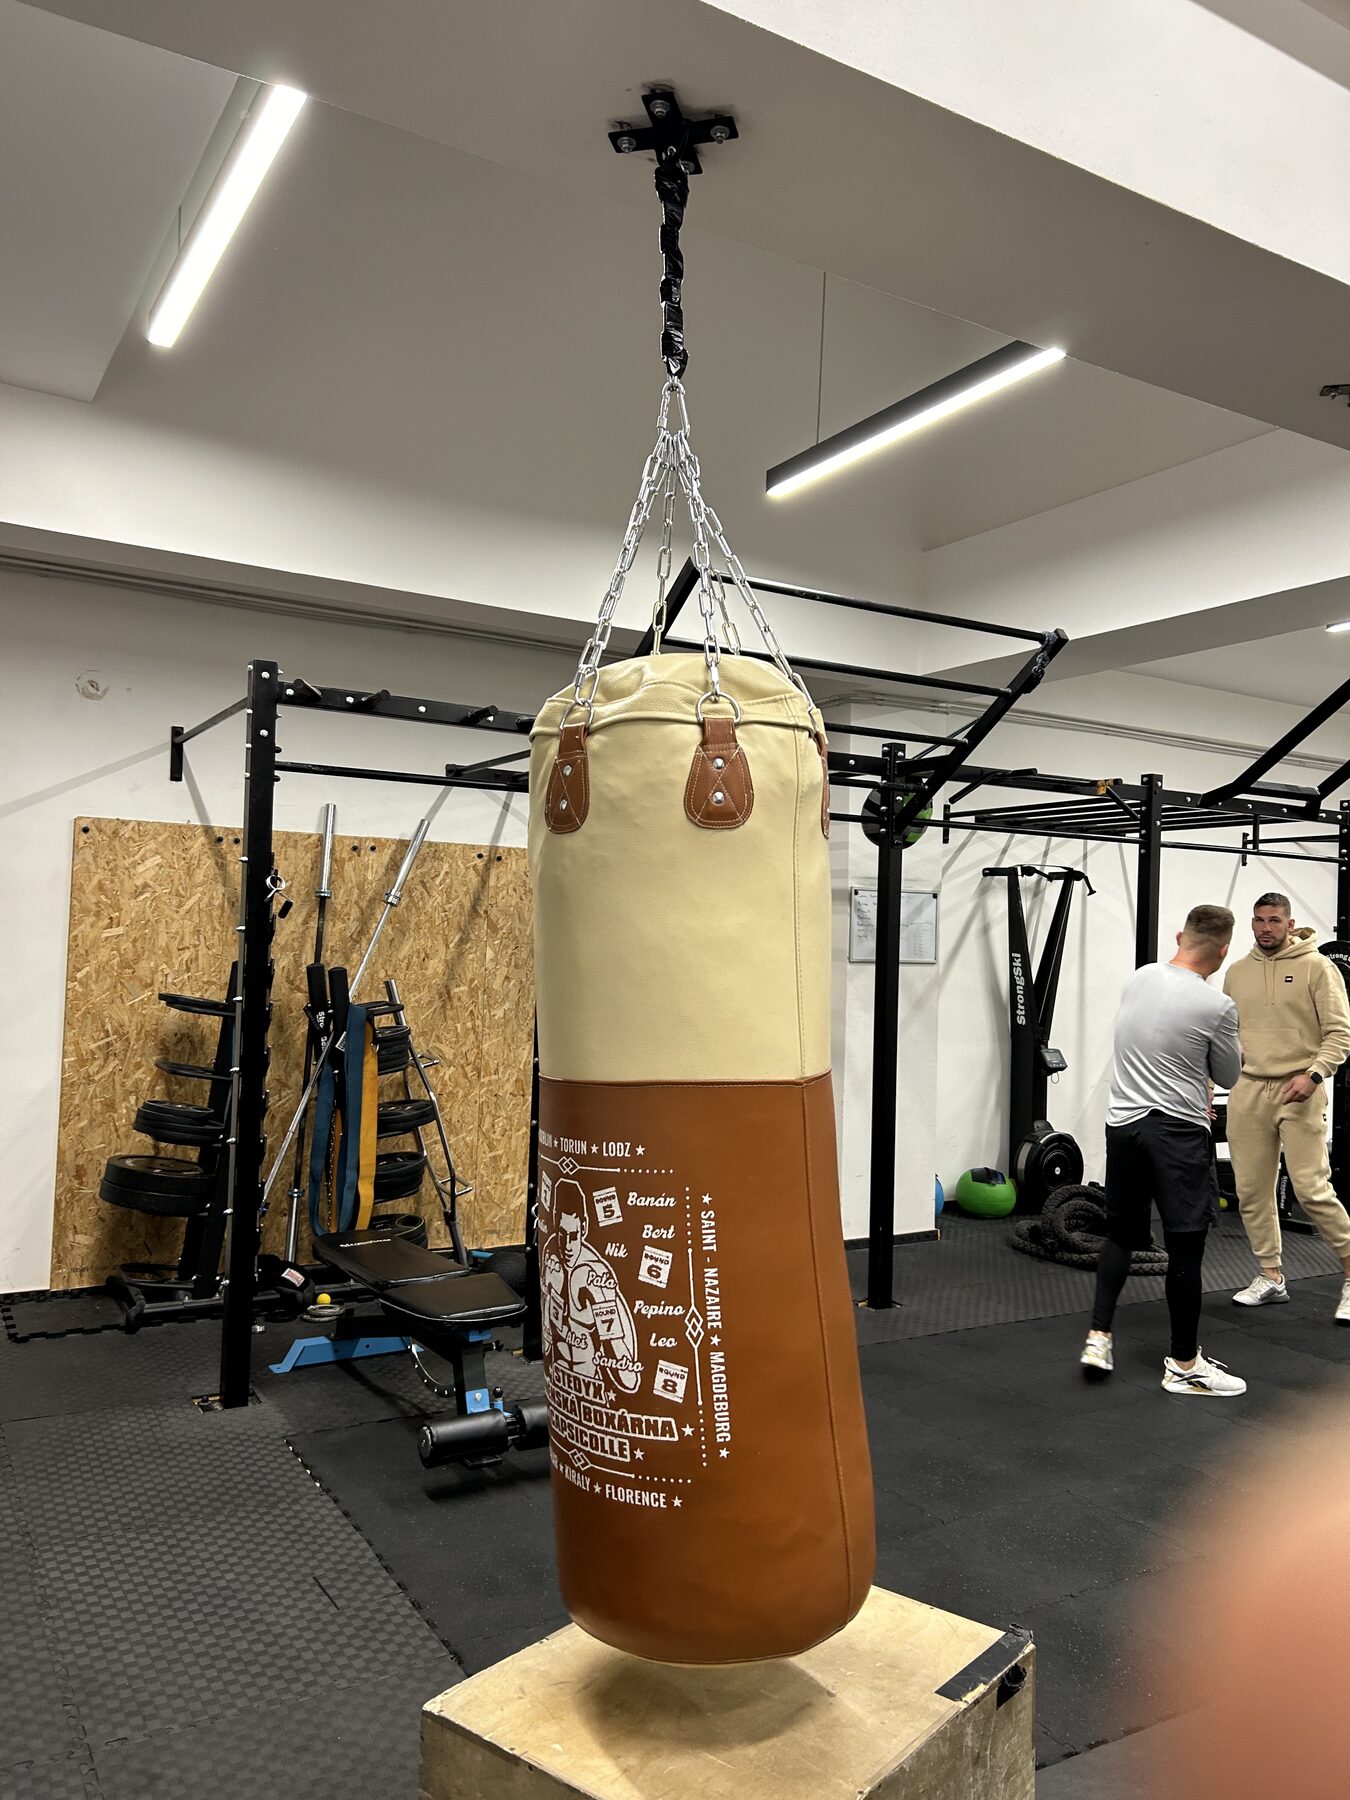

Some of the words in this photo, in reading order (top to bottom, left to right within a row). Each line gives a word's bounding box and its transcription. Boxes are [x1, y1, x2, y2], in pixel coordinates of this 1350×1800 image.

[1012, 952, 1026, 1026] StrongSki
[560, 1137, 587, 1155] TORUN
[603, 1141, 631, 1157] LODZ
[627, 1191, 677, 1207] Banán
[602, 1204, 615, 1218] 5
[642, 1224, 676, 1239] Bert
[701, 1210, 717, 1252] SAINT
[605, 1242, 628, 1258] Nik
[644, 1252, 669, 1265] ROUND
[647, 1264, 662, 1279] 6
[704, 1267, 722, 1329] NAZAIRE
[594, 1308, 616, 1317] ROUND
[633, 1300, 686, 1319] Pepino
[601, 1318, 614, 1332] 7
[649, 1332, 678, 1348] Leo
[592, 1351, 644, 1373] Sandro
[659, 1367, 685, 1380] ROUND
[661, 1378, 677, 1394] 8
[709, 1351, 732, 1443] MAGDEBURG
[582, 1402, 678, 1440] BOXÁRNA
[565, 1464, 590, 1491] KIRALY
[605, 1483, 667, 1508] FLORENCE
